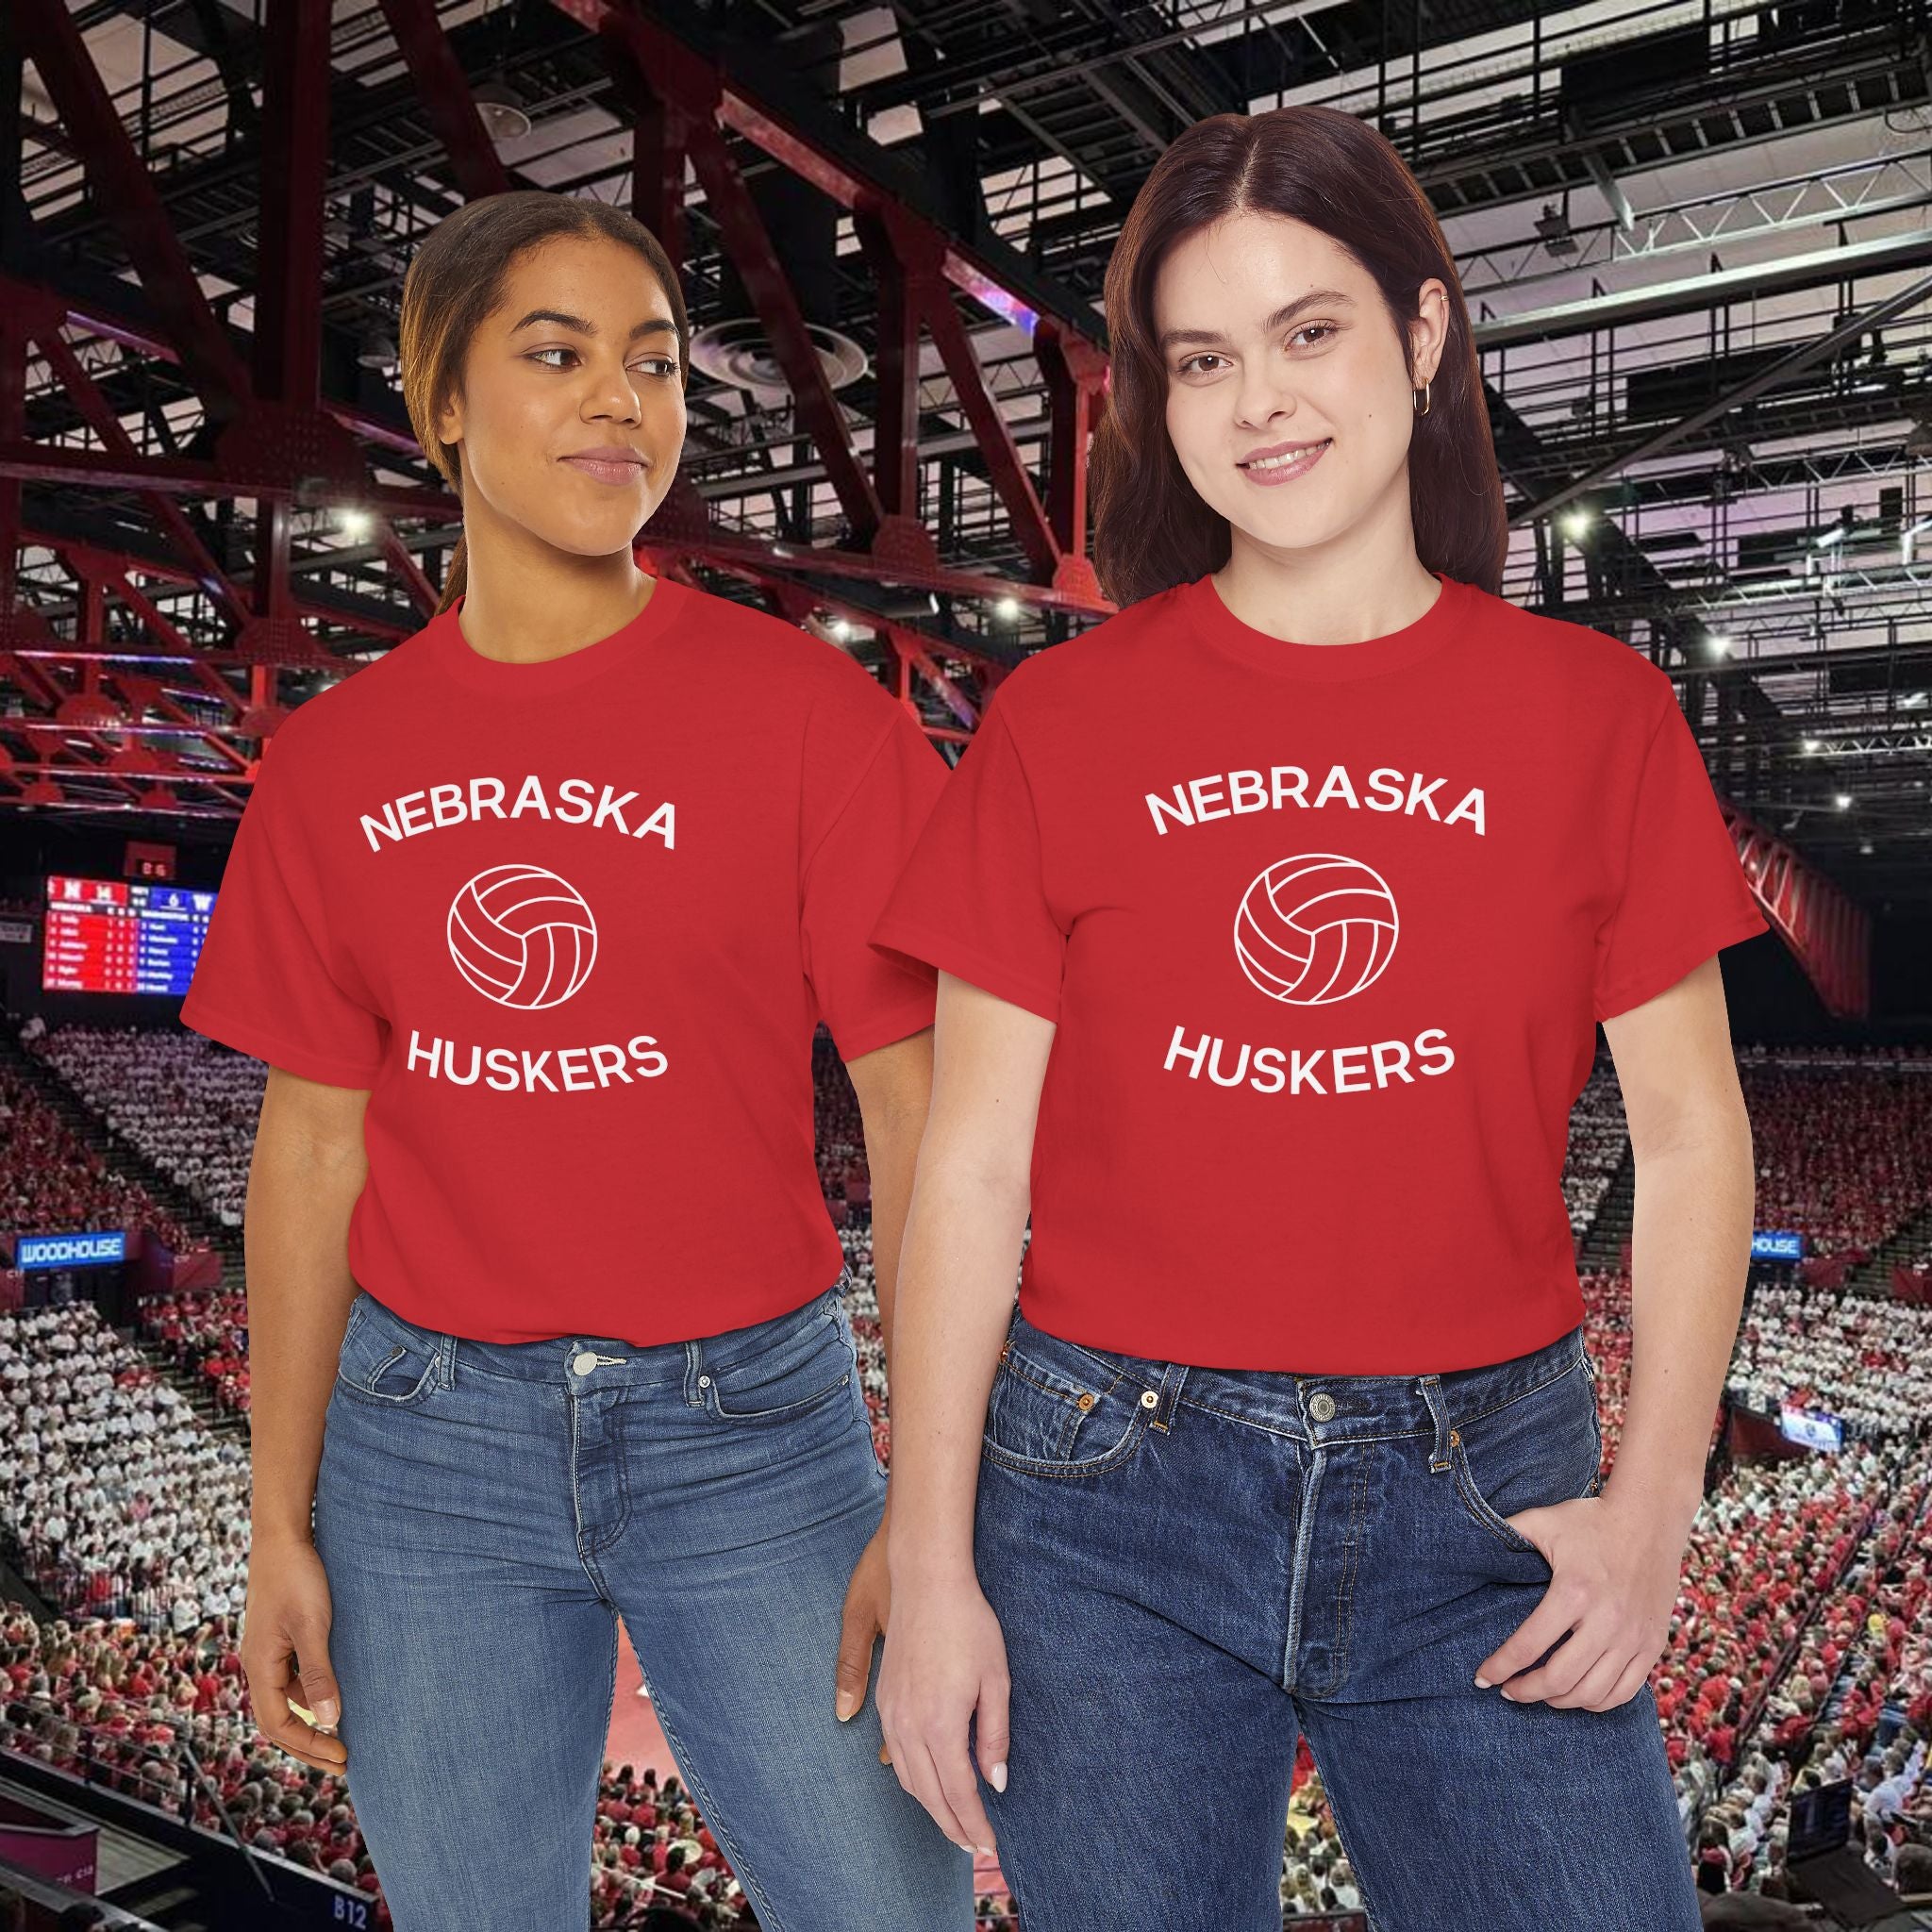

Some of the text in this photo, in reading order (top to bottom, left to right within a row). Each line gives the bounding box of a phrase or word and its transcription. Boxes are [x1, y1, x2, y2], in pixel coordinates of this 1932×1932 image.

[359, 774, 675, 853] NEBRASKA
[1144, 765, 1486, 837] NEBRASKA
[168, 893, 180, 908] 6
[192, 894, 212, 910] W
[407, 1029, 669, 1092] HUSKERS
[1163, 1024, 1456, 1095] HUSKERS
[22, 1238, 122, 1263] WOODHOUSE
[334, 1894, 367, 1930] B12
